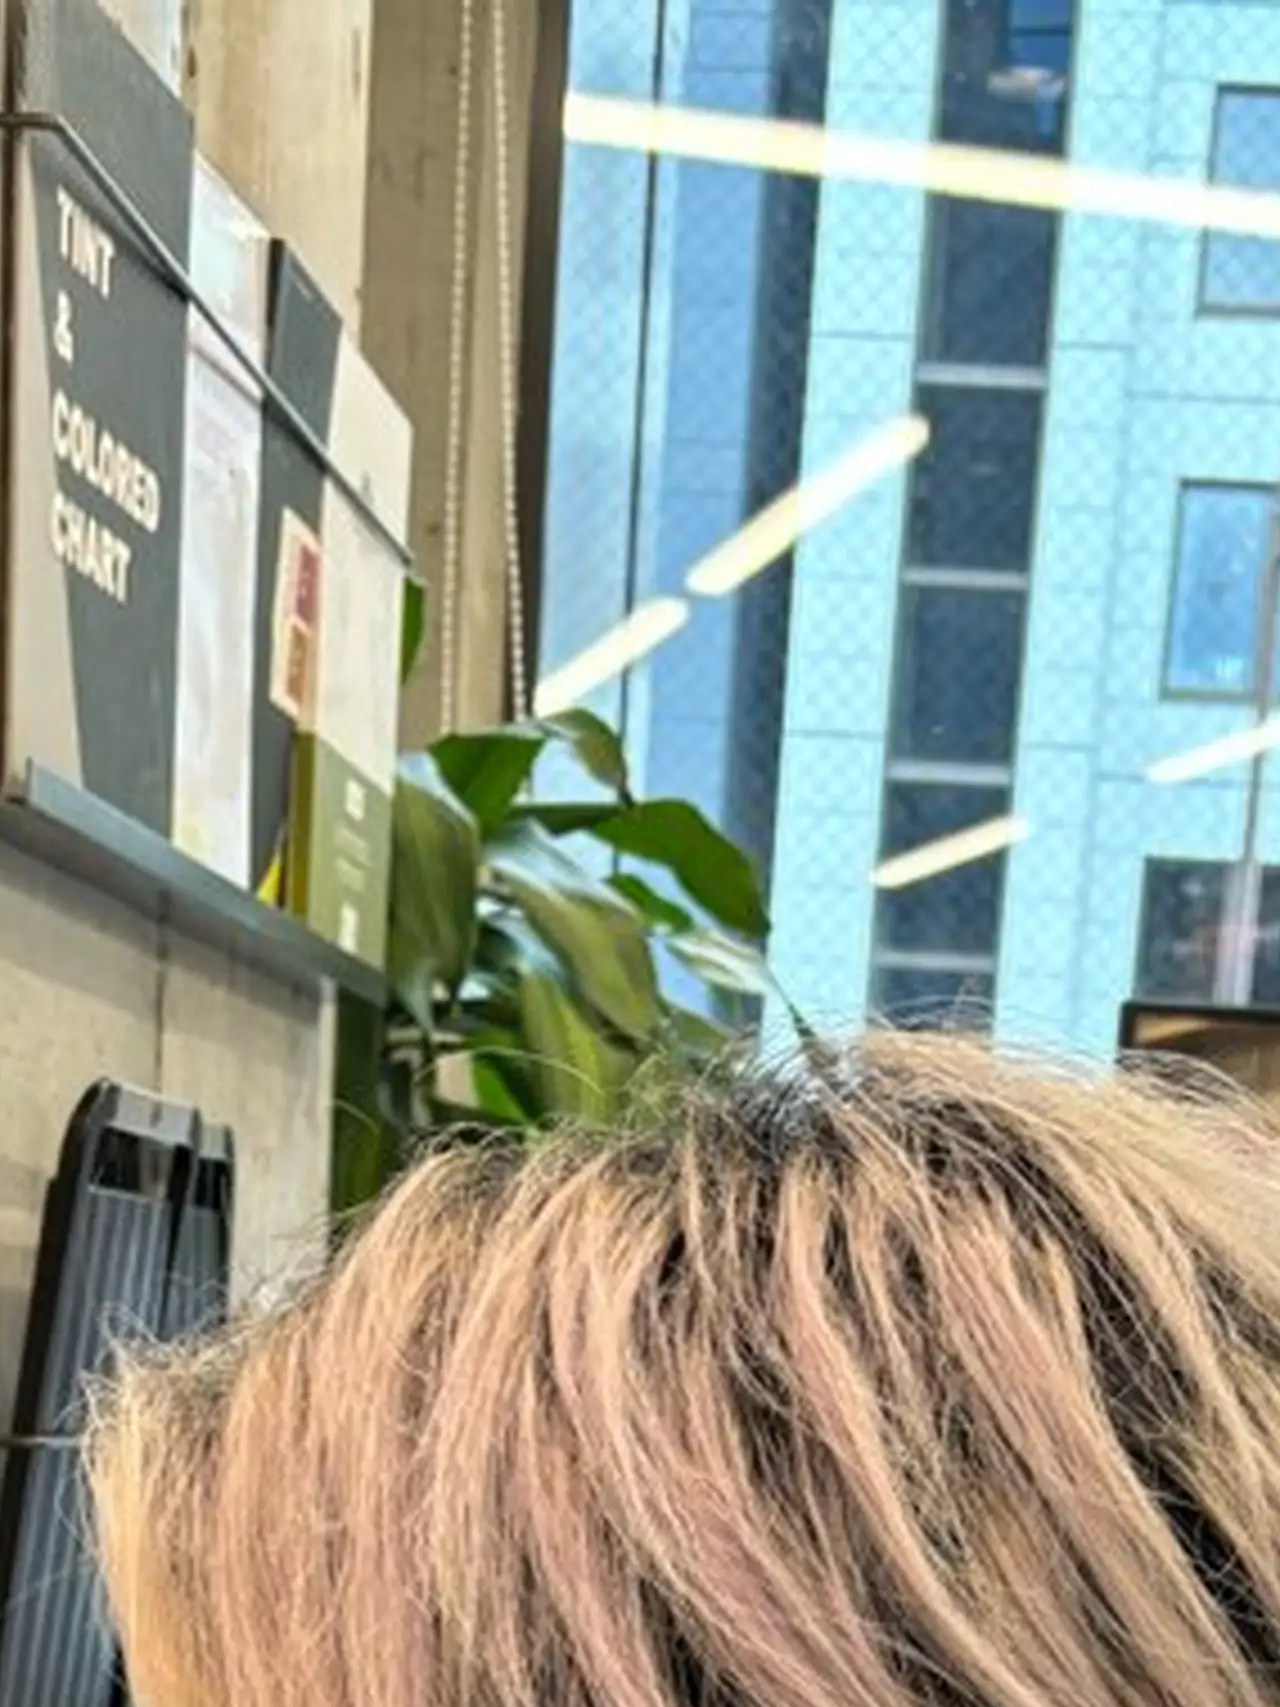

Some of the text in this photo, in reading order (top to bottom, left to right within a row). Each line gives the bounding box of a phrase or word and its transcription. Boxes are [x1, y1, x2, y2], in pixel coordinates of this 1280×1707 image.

[56, 183, 116, 299] TINT
[53, 289, 74, 364] &
[52, 389, 161, 533] COLORED
[50, 490, 132, 603] CHART
